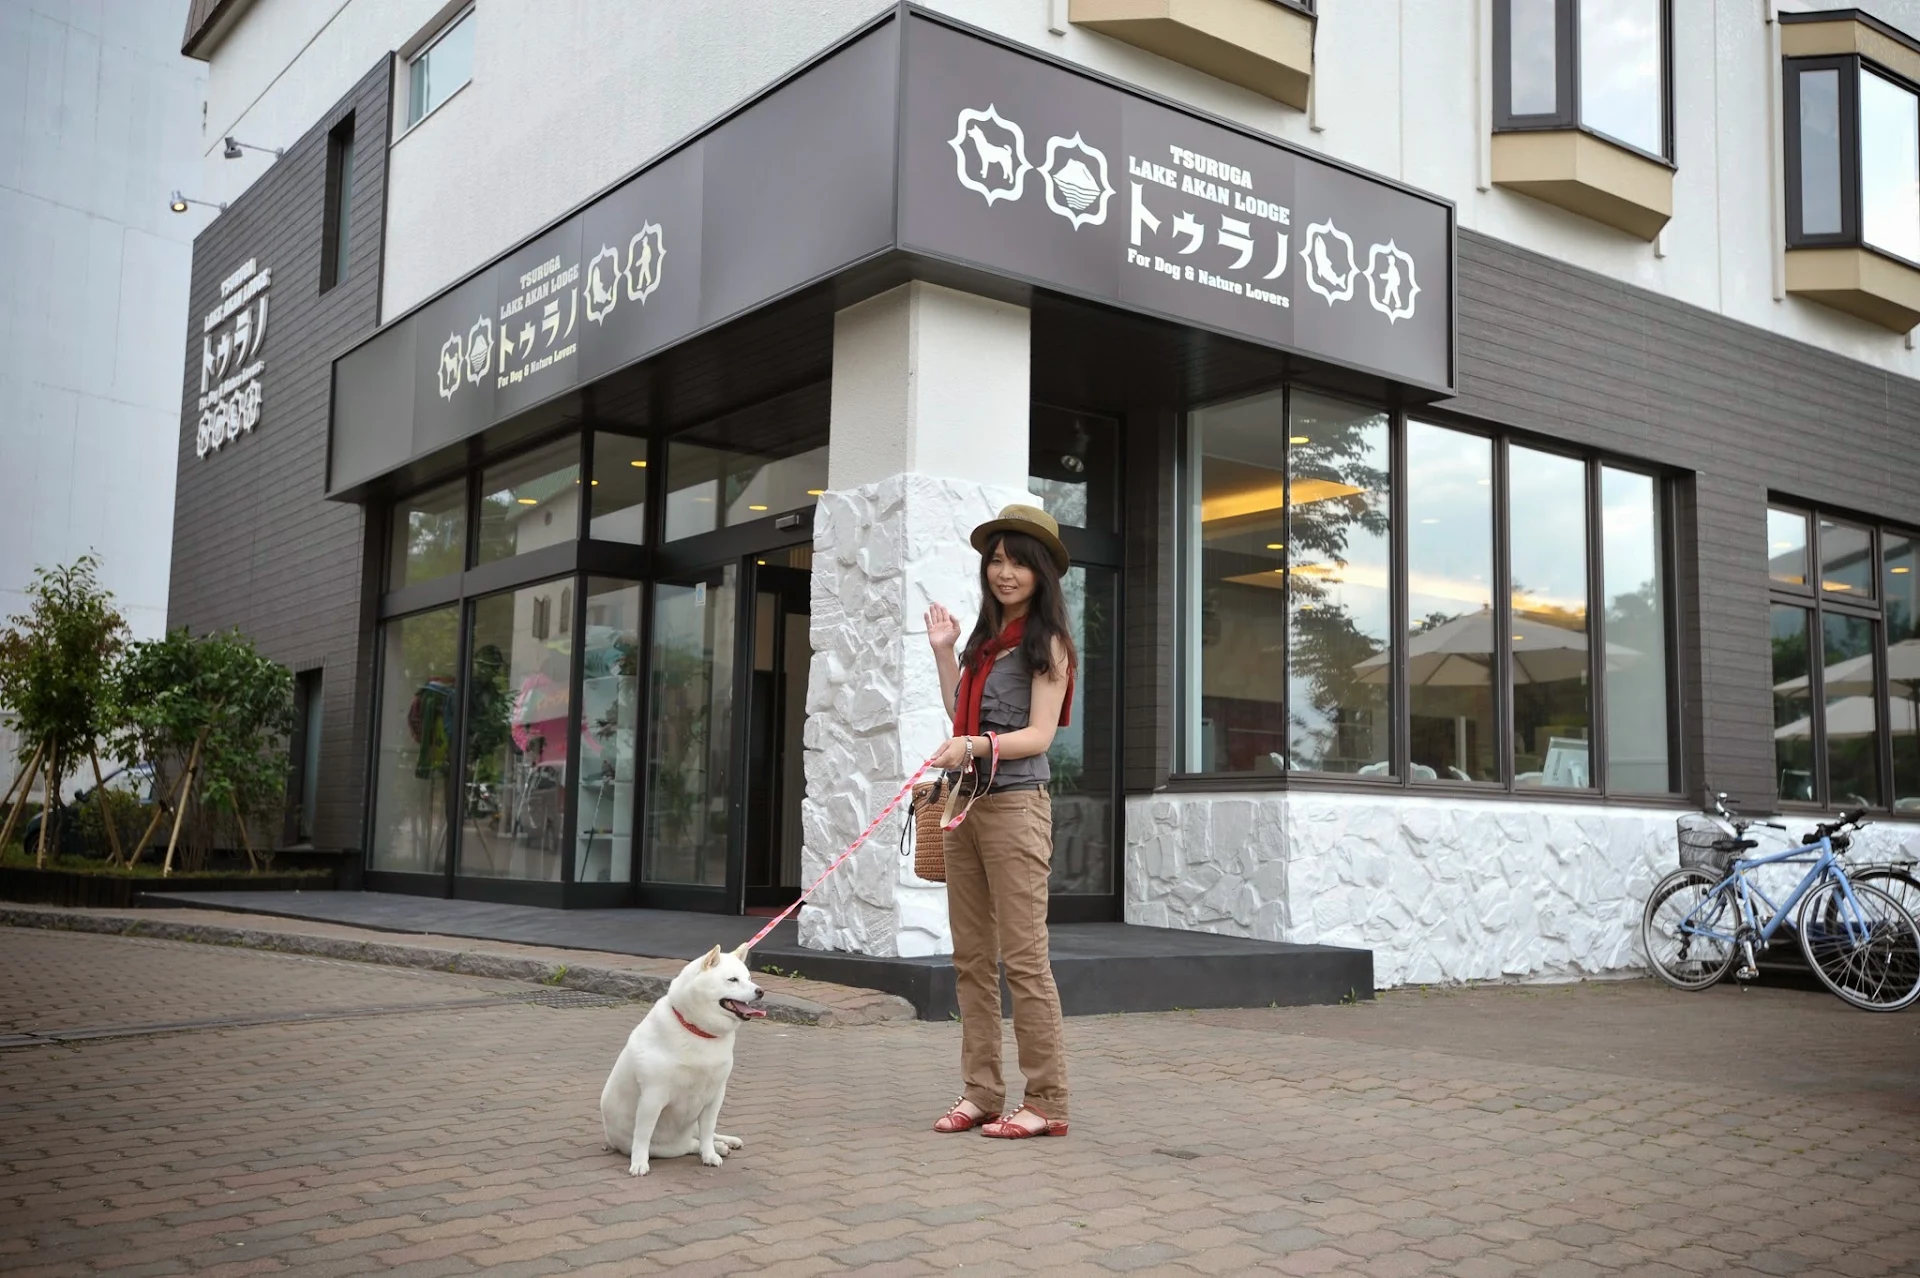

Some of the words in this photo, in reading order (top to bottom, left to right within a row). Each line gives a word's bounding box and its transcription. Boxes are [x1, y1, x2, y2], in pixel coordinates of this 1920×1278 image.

[1128, 155, 1178, 189] LAKE
[1181, 174, 1230, 206] AKAN
[1234, 191, 1291, 226] LODGE
[1170, 144, 1253, 190] TSURUGA
[500, 295, 524, 320] LAKE
[524, 281, 550, 309] AKAN
[550, 262, 579, 294] LODGE
[520, 254, 561, 290] TSURUGA
[1127, 247, 1151, 268] For
[1154, 255, 1181, 281] Dog
[1184, 265, 1195, 281] &
[1198, 269, 1243, 295] Nature
[1246, 282, 1290, 309] Lovers
[497, 375, 509, 389] For
[509, 369, 523, 384] Dog
[530, 355, 553, 374] Nature
[553, 342, 577, 363] Lovers
